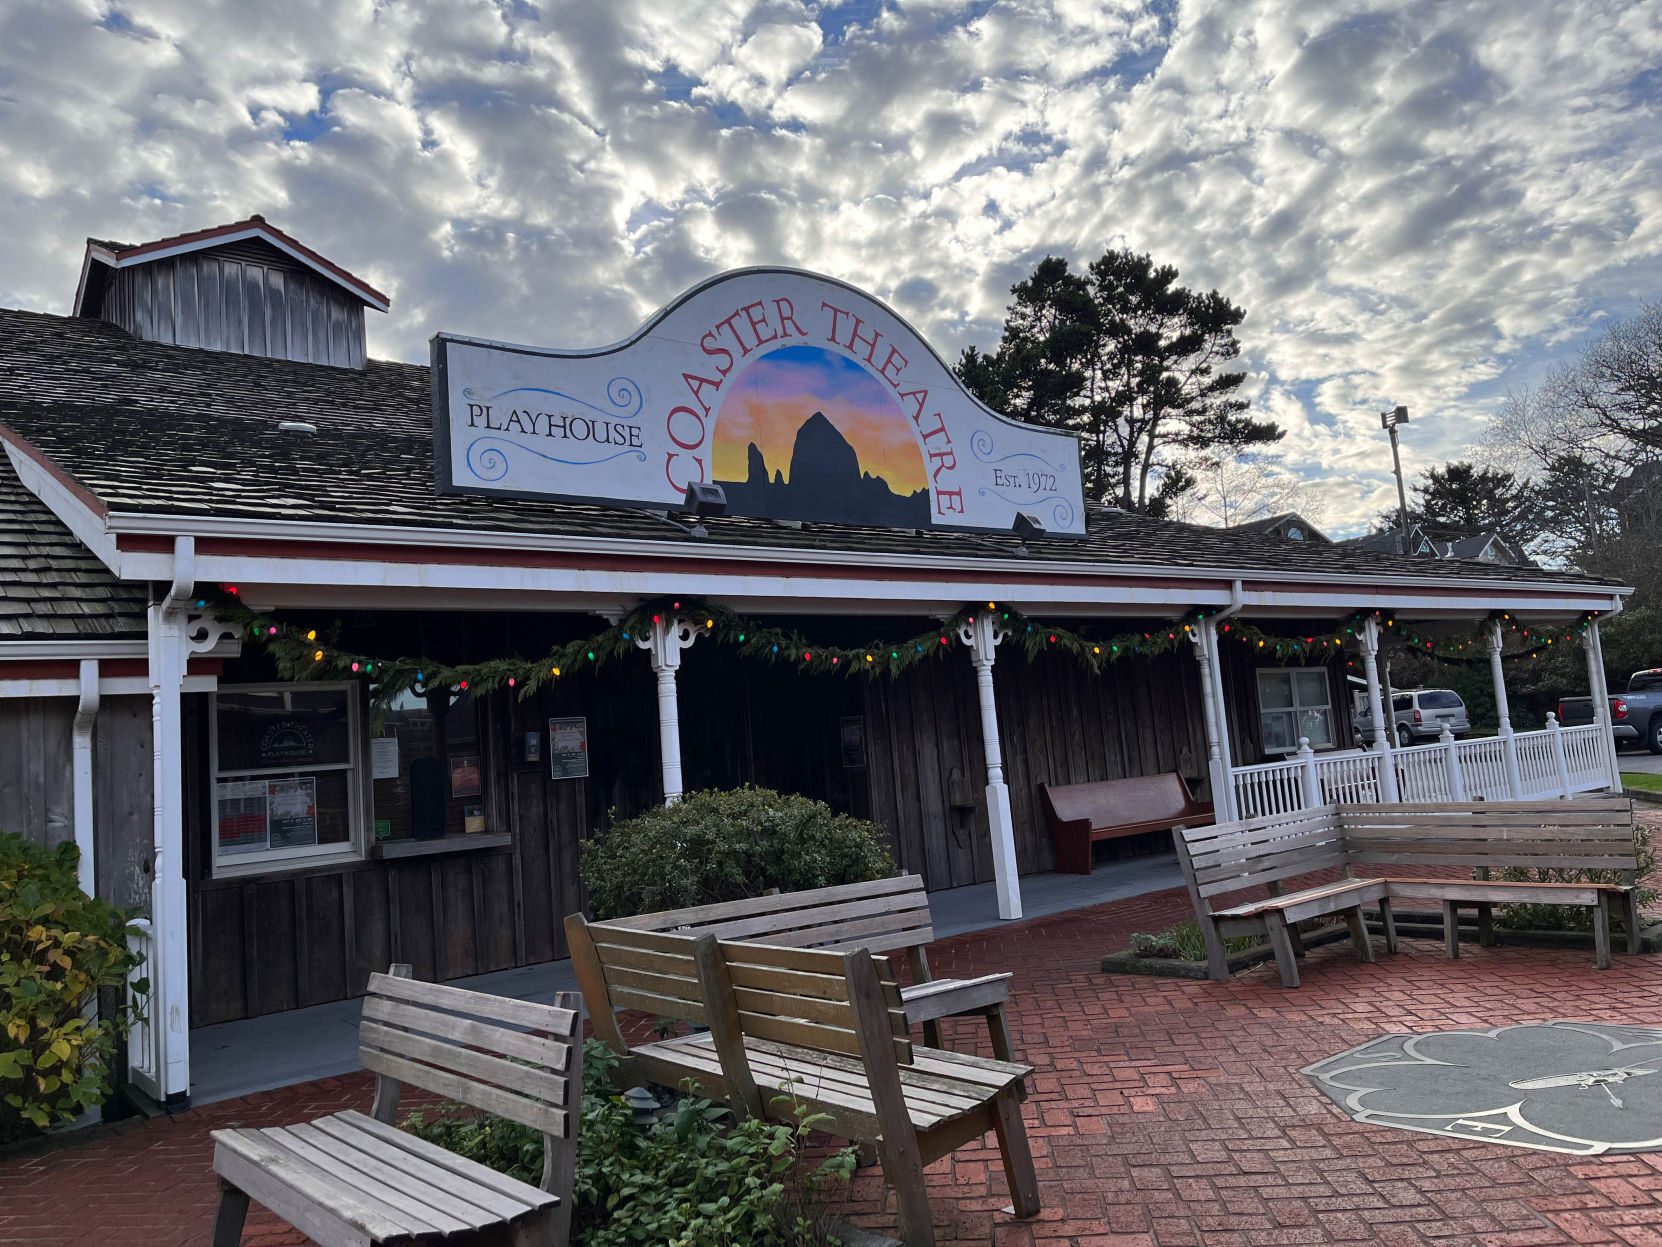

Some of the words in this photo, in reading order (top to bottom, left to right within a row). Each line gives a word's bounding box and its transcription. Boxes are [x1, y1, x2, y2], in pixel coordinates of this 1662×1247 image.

[466, 402, 643, 449] PLAYHOUSE
[666, 297, 809, 495] COASTER
[821, 301, 965, 516] THEATRE
[1025, 472, 1057, 493] 1972
